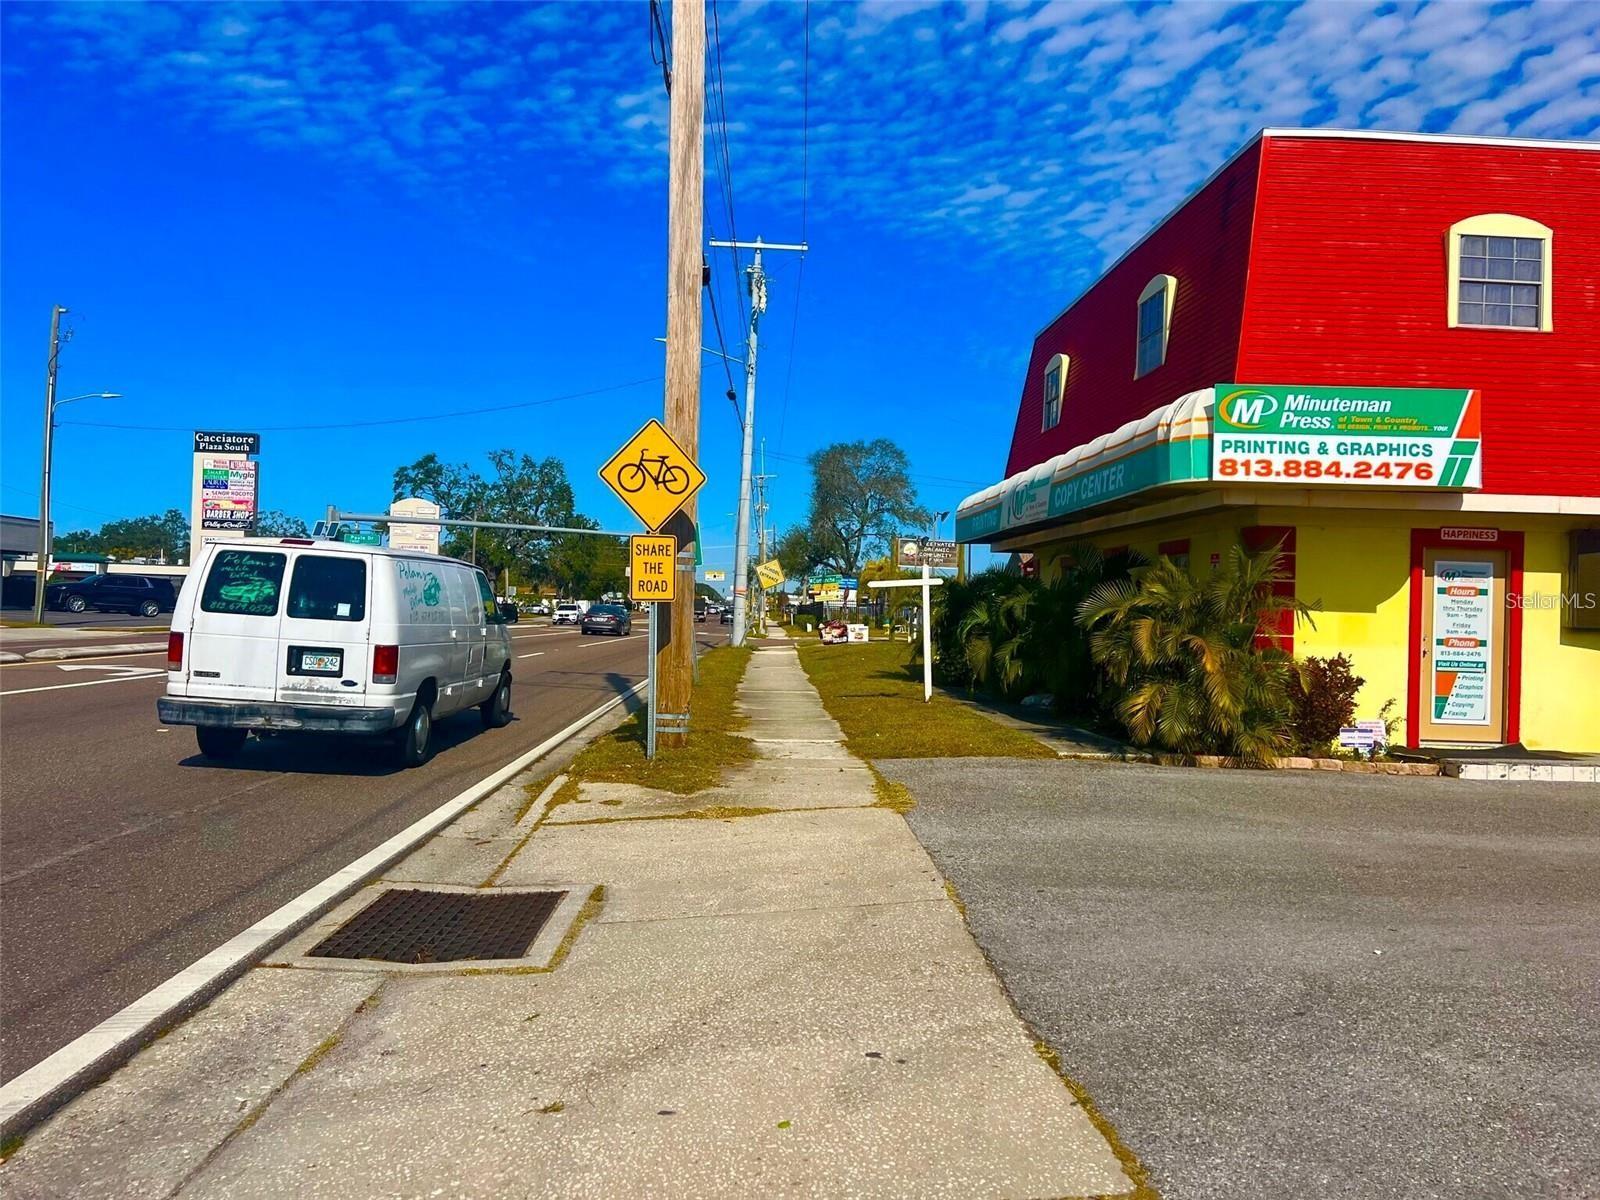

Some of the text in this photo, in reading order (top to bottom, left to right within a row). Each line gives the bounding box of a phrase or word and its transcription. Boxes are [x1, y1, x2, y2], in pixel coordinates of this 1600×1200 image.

[1283, 394, 1392, 413] Minuteman
[1351, 415, 1373, 423] Town
[1384, 416, 1418, 425] Country
[195, 432, 255, 444] Cacciatore
[199, 442, 250, 452] Plaza South
[1221, 439, 1434, 457] PRINTING & GRAPHICS
[1218, 458, 1434, 481] 813.884.2476
[1054, 463, 1125, 508] COPY CENTER
[1442, 529, 1496, 540] HAPPINESS
[635, 543, 672, 557] SHARE
[643, 561, 664, 575] THE
[638, 580, 668, 593] ROAD
[1450, 588, 1477, 596] Hours
[1447, 638, 1477, 648] Phone
[324, 658, 338, 668] 242
[1451, 701, 1475, 709] Copying
